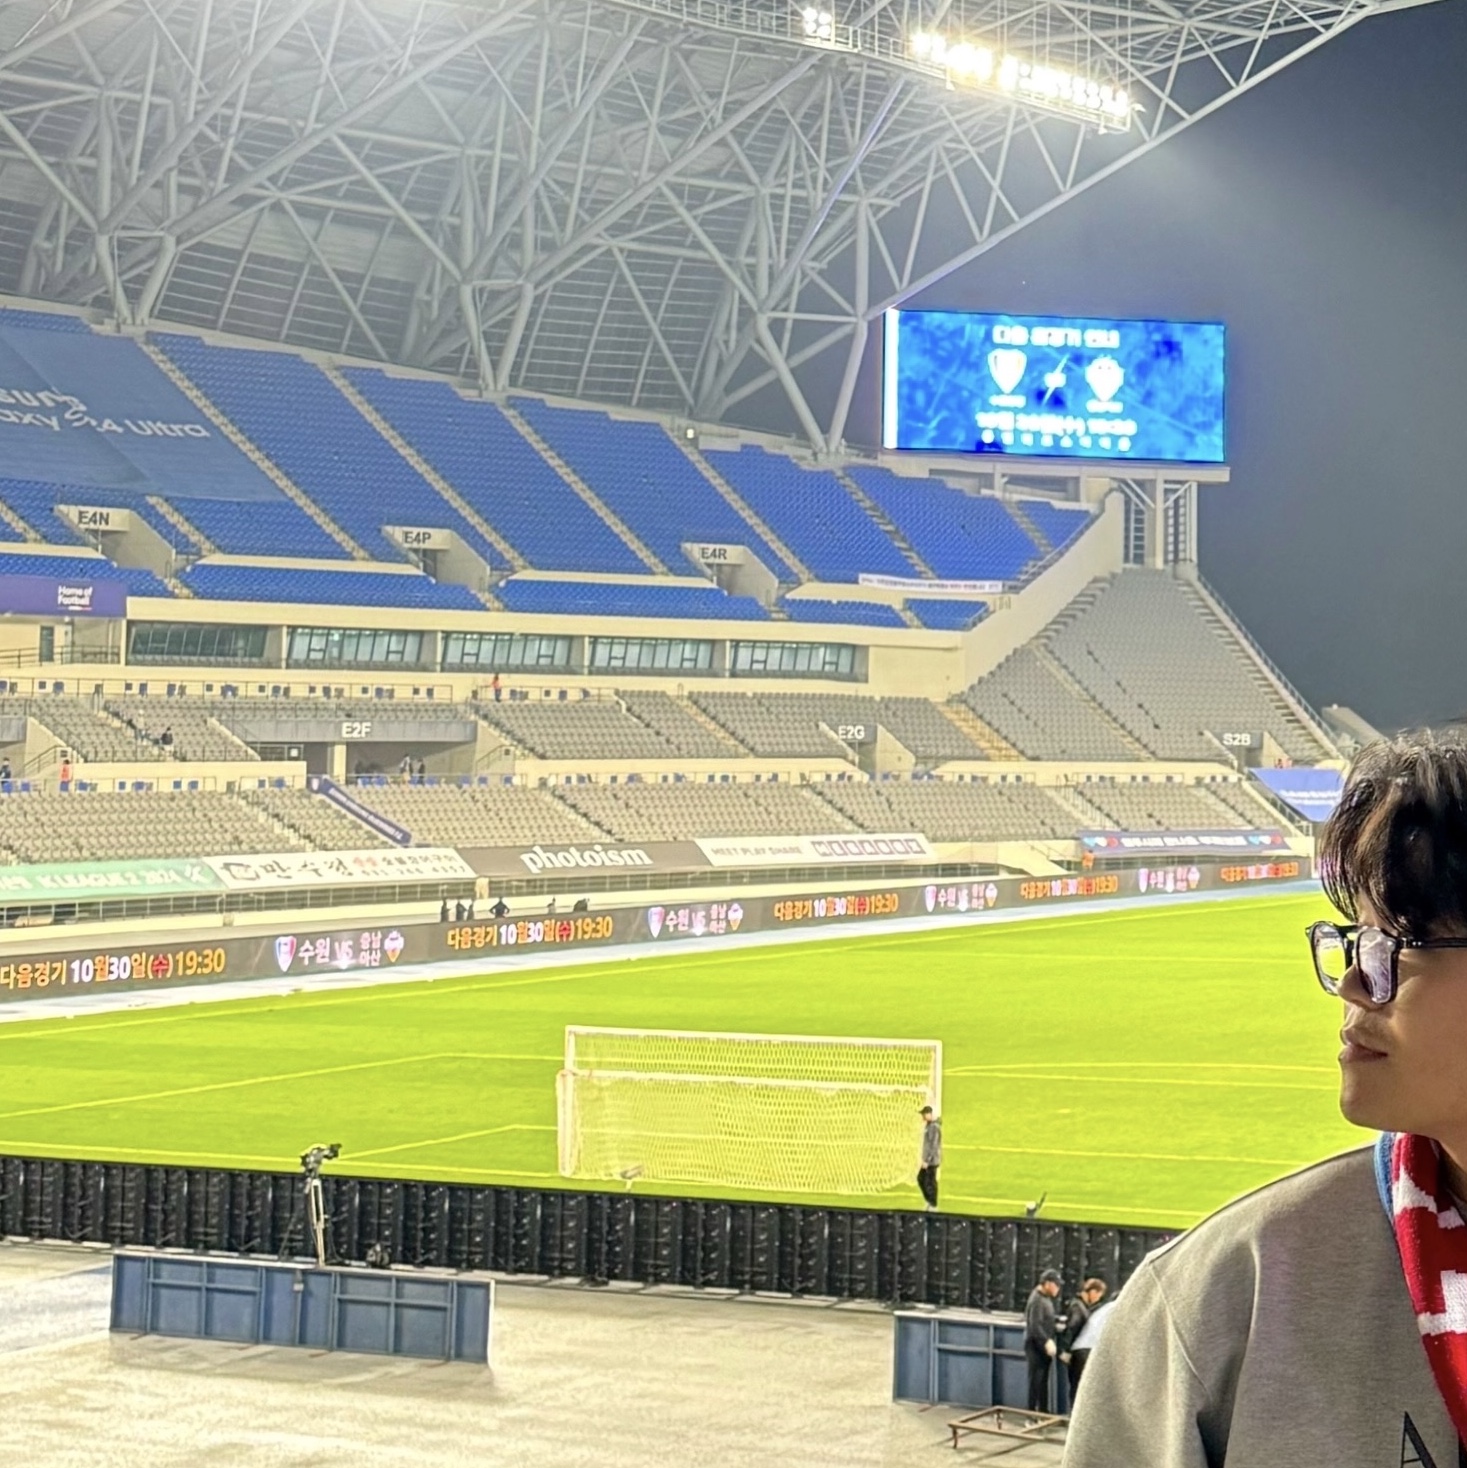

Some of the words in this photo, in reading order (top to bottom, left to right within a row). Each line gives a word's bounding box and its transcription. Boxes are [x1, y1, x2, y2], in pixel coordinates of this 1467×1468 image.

[124, 420, 210, 437] Ultra
[78, 510, 110, 525] E4N
[404, 531, 431, 544] E4P
[700, 547, 727, 560] E4R
[342, 722, 371, 738] E2F
[838, 725, 865, 739] E2G
[1223, 733, 1251, 745] S2B
[520, 844, 653, 874] photoism
[774, 898, 812, 921] 다음경기
[870, 893, 899, 914] 19:30
[447, 925, 498, 949] 다음경기
[576, 916, 613, 939] 19:30
[298, 937, 330, 966] 수원
[0, 959, 67, 989] 다음경기
[176, 948, 226, 976] 19:30
